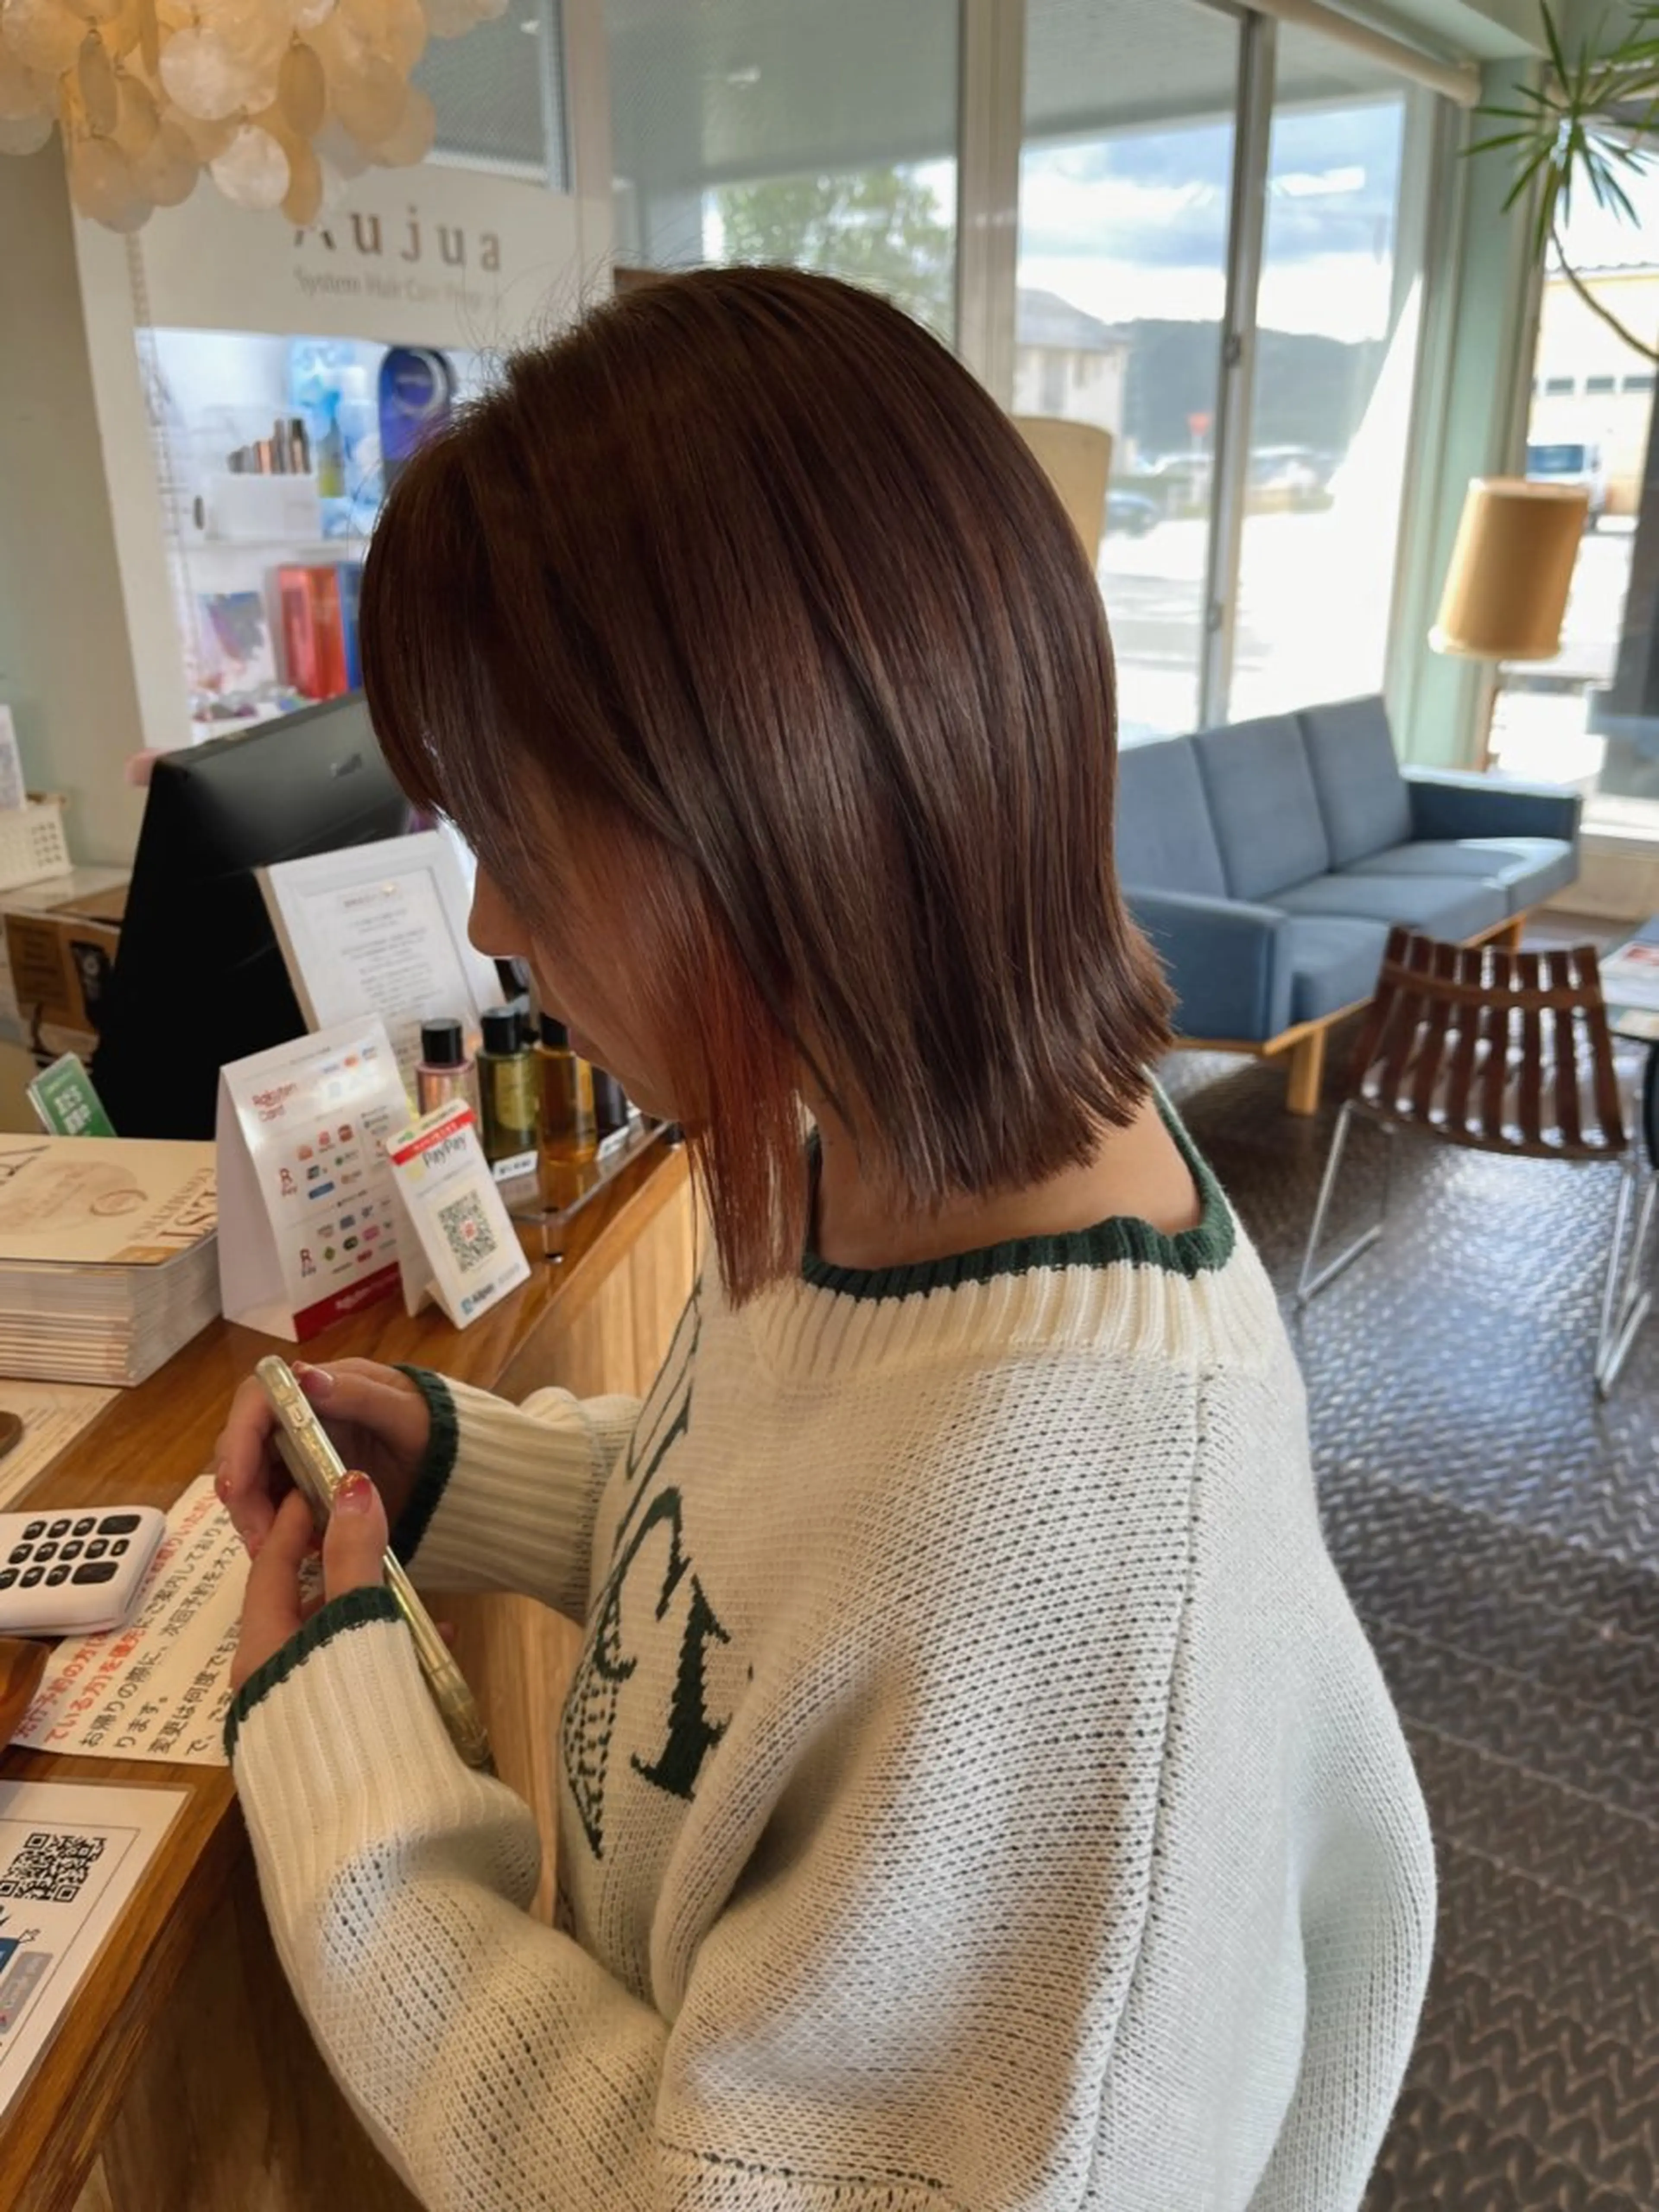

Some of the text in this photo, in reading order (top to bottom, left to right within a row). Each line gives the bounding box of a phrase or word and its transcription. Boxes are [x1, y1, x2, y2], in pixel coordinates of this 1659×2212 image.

[422, 1133, 467, 1168] PayPay
[147, 1617, 241, 1753] 変更は何度でも可
[114, 1696, 168, 1748] ります。
